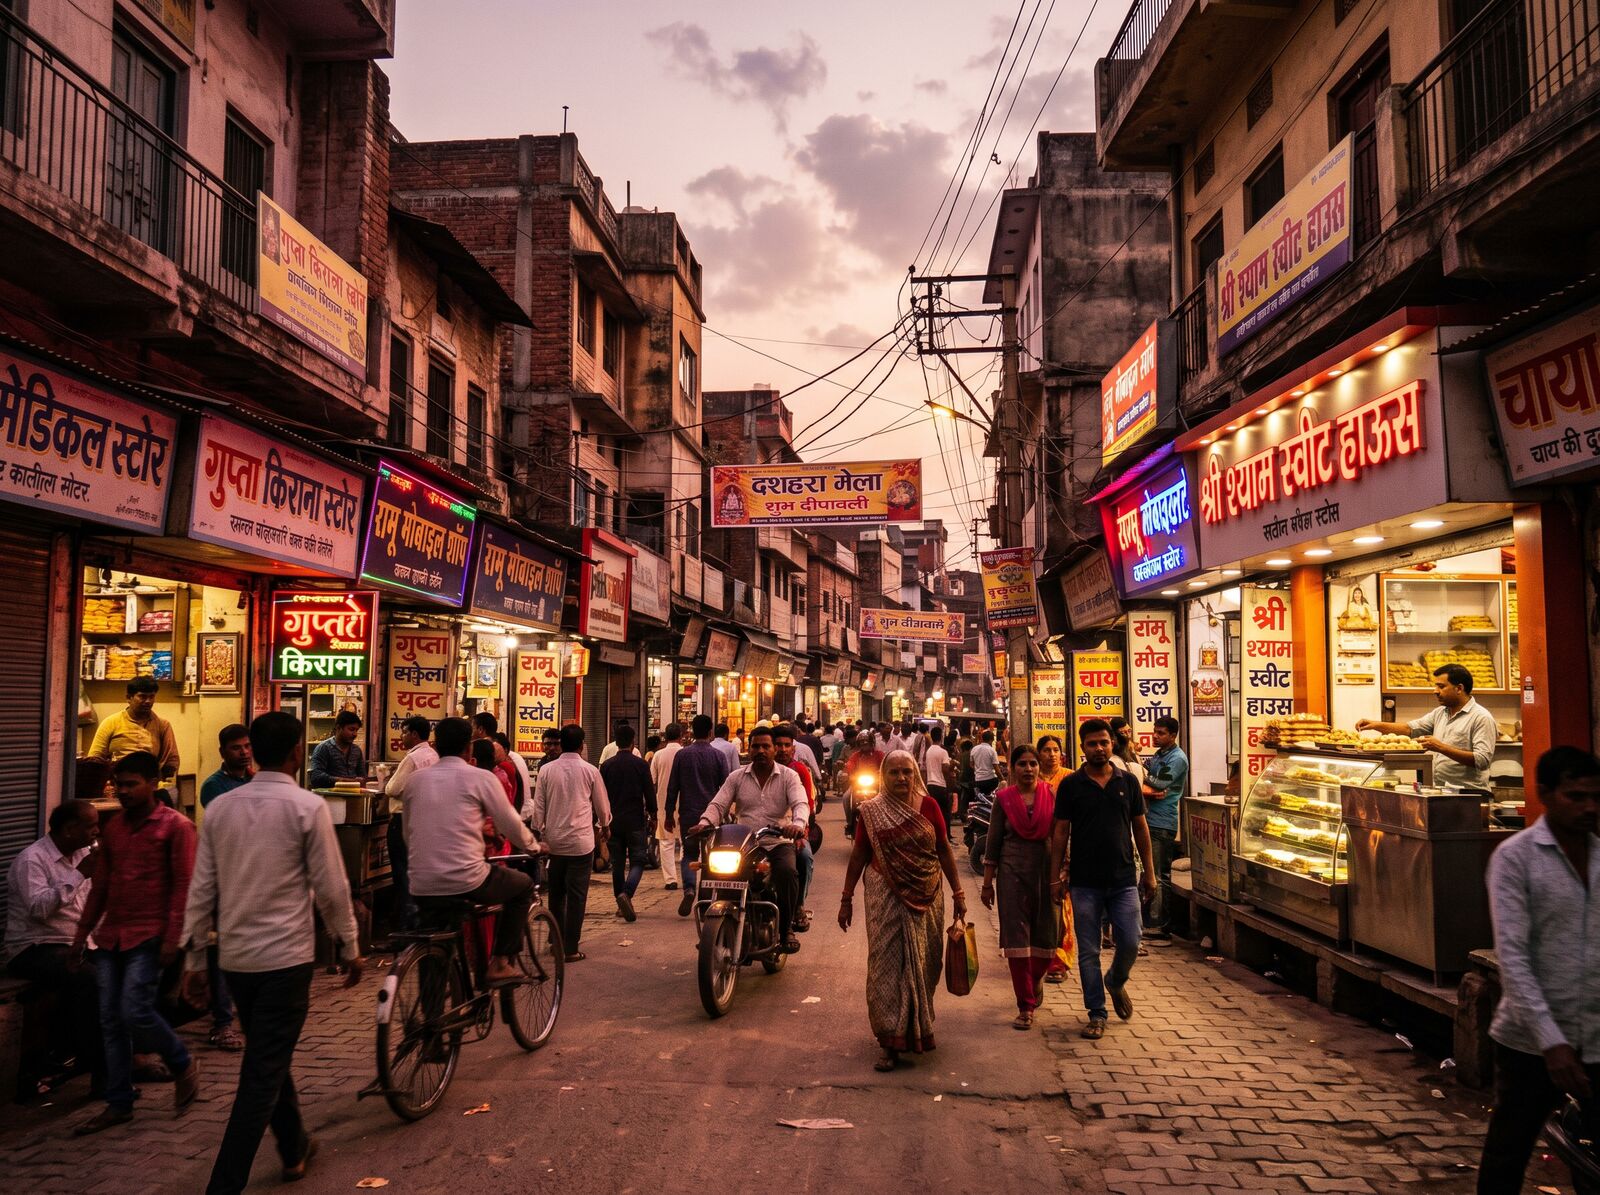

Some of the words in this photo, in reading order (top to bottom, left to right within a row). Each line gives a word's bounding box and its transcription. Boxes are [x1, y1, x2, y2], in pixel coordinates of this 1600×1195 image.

[1221, 268, 1235, 321] श्री
[112, 415, 169, 487] स्टोर
[1530, 440, 1560, 464] चाय
[1561, 427, 1582, 455] की
[1584, 427, 1600, 457] दु
[1201, 453, 1222, 524] श्री
[1226, 447, 1276, 516] श्याम
[1279, 407, 1333, 496] स्वीट
[205, 439, 262, 508] गुप्ता
[263, 448, 323, 521] किराना
[324, 478, 358, 535] स्टोर
[751, 475, 828, 496] दशहरा
[834, 469, 883, 492] मेला
[765, 501, 796, 517] शुभ
[800, 495, 870, 512] दीपावली
[374, 499, 401, 558] रामू
[484, 543, 507, 592] रामू
[1252, 596, 1287, 631] श्री
[395, 635, 449, 661] गुप्ता
[1134, 645, 1170, 669] मोव
[1246, 640, 1293, 658] श्याम
[279, 647, 365, 676] किराना
[521, 655, 558, 679] रामू
[1079, 671, 1119, 688] चाय
[1137, 678, 1170, 697] इल
[1249, 662, 1291, 688] स्वीट
[1077, 692, 1091, 706] की
[1136, 701, 1173, 723] शॉप
[1246, 697, 1293, 716] हाउस
